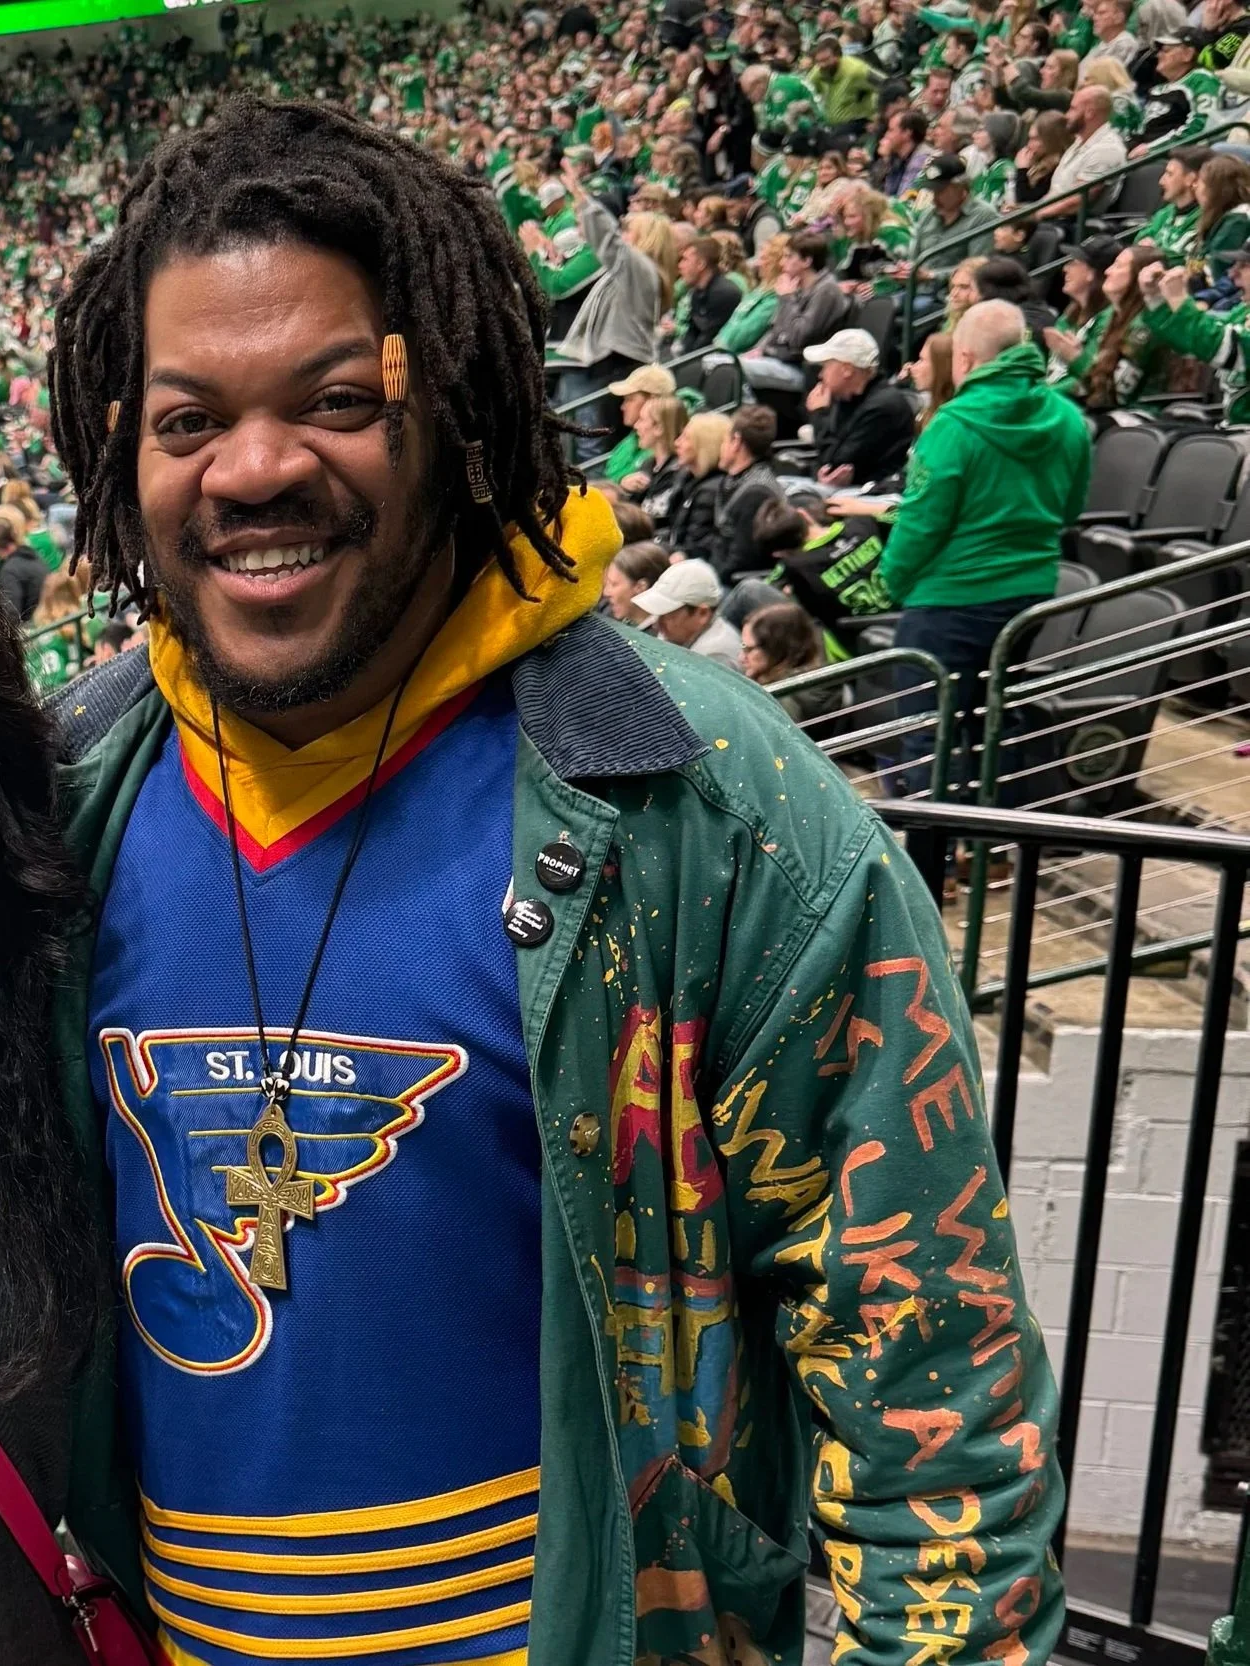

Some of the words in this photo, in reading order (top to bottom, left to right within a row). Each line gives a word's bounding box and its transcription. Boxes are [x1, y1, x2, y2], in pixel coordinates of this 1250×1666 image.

[537, 852, 581, 878] PROPHET
[206, 1050, 255, 1081] ST.
[865, 957, 975, 1152] ME
[840, 1140, 934, 1360] LIKE
[882, 1408, 964, 1472] A
